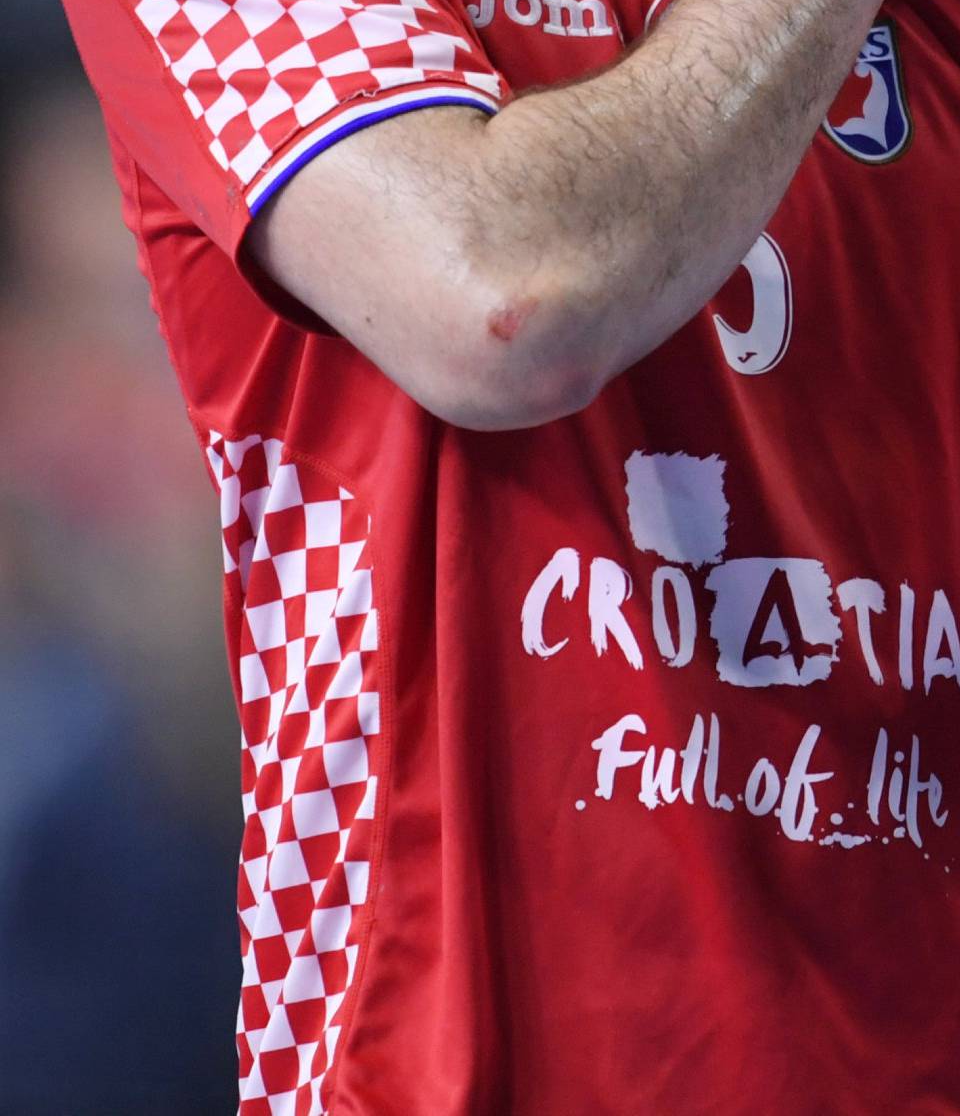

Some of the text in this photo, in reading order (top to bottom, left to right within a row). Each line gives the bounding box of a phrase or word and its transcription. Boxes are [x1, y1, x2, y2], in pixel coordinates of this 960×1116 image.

[591, 713, 949, 848] Full of life
